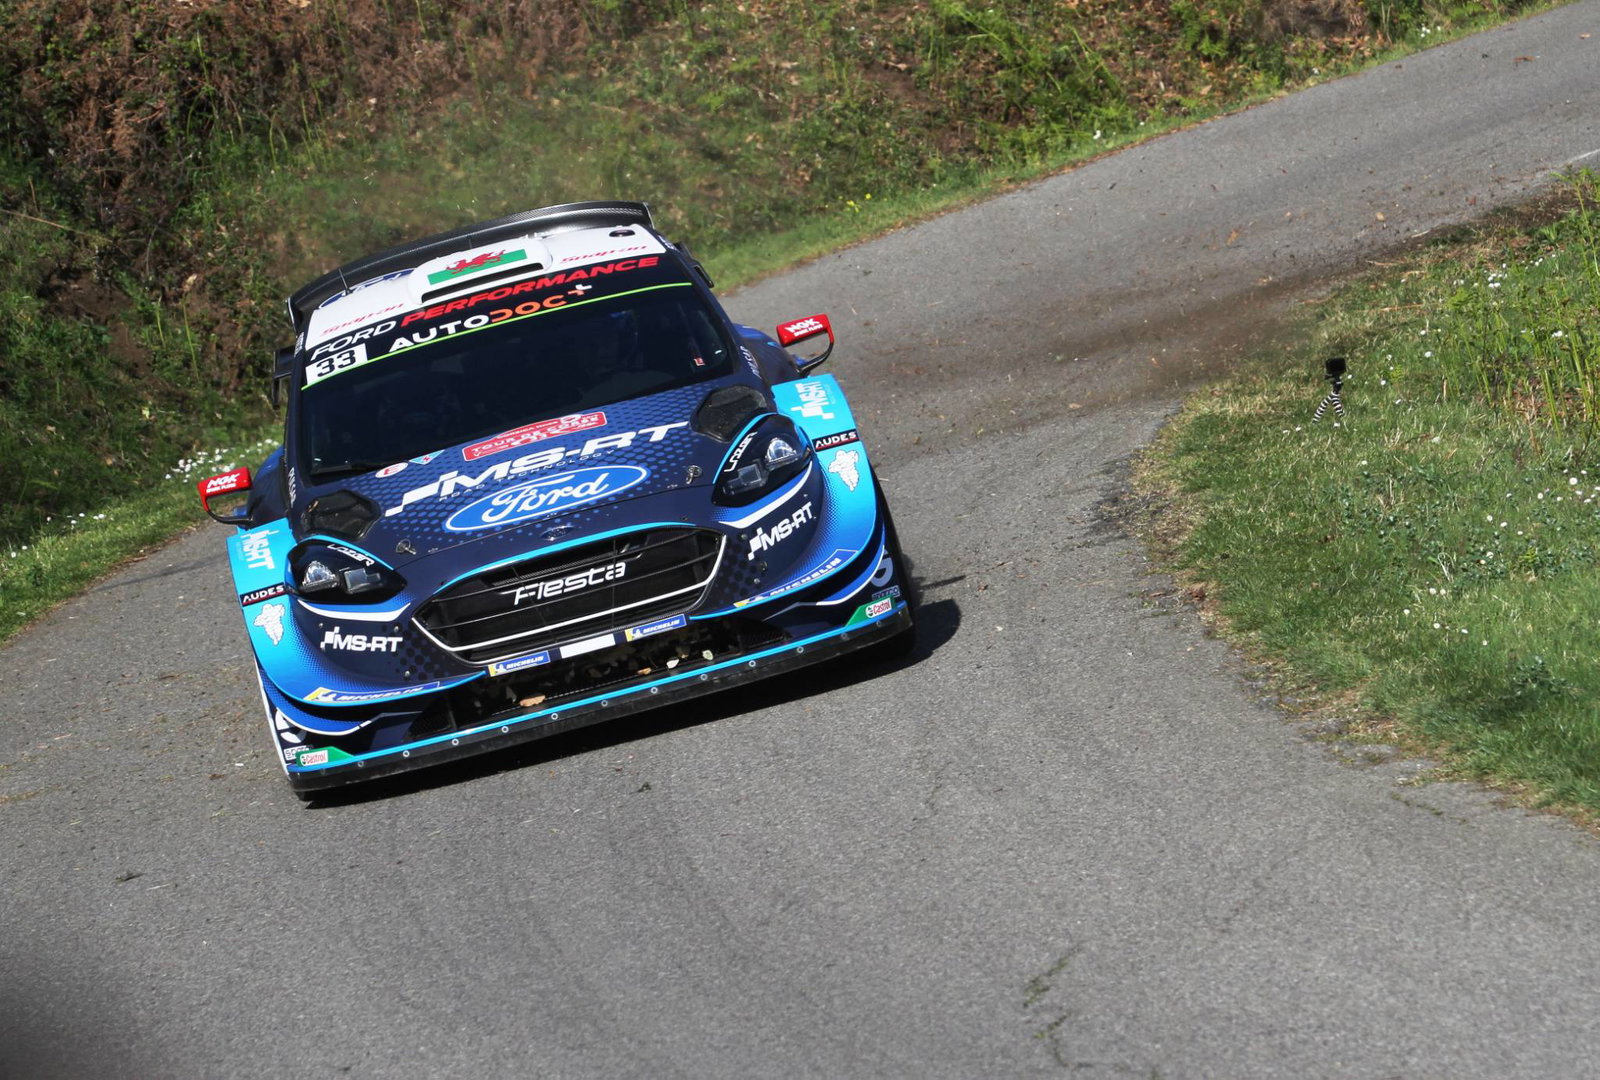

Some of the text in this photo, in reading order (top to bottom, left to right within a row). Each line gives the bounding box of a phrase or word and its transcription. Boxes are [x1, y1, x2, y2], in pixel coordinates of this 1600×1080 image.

[310, 320, 397, 361] FORD
[400, 256, 660, 327] PERFORMANCE
[316, 349, 357, 378] 33
[471, 437, 516, 453] TOUR
[815, 431, 857, 449] AUDES
[440, 421, 689, 498] MS-RT
[496, 449, 615, 483] TECHNOLOGY
[481, 472, 610, 523] Ford
[760, 502, 813, 551] MS-RT
[242, 585, 285, 604] AUDES
[642, 619, 681, 635] MICHELIN
[333, 633, 403, 652] MS-RT
[505, 655, 545, 671] MICHELIN
